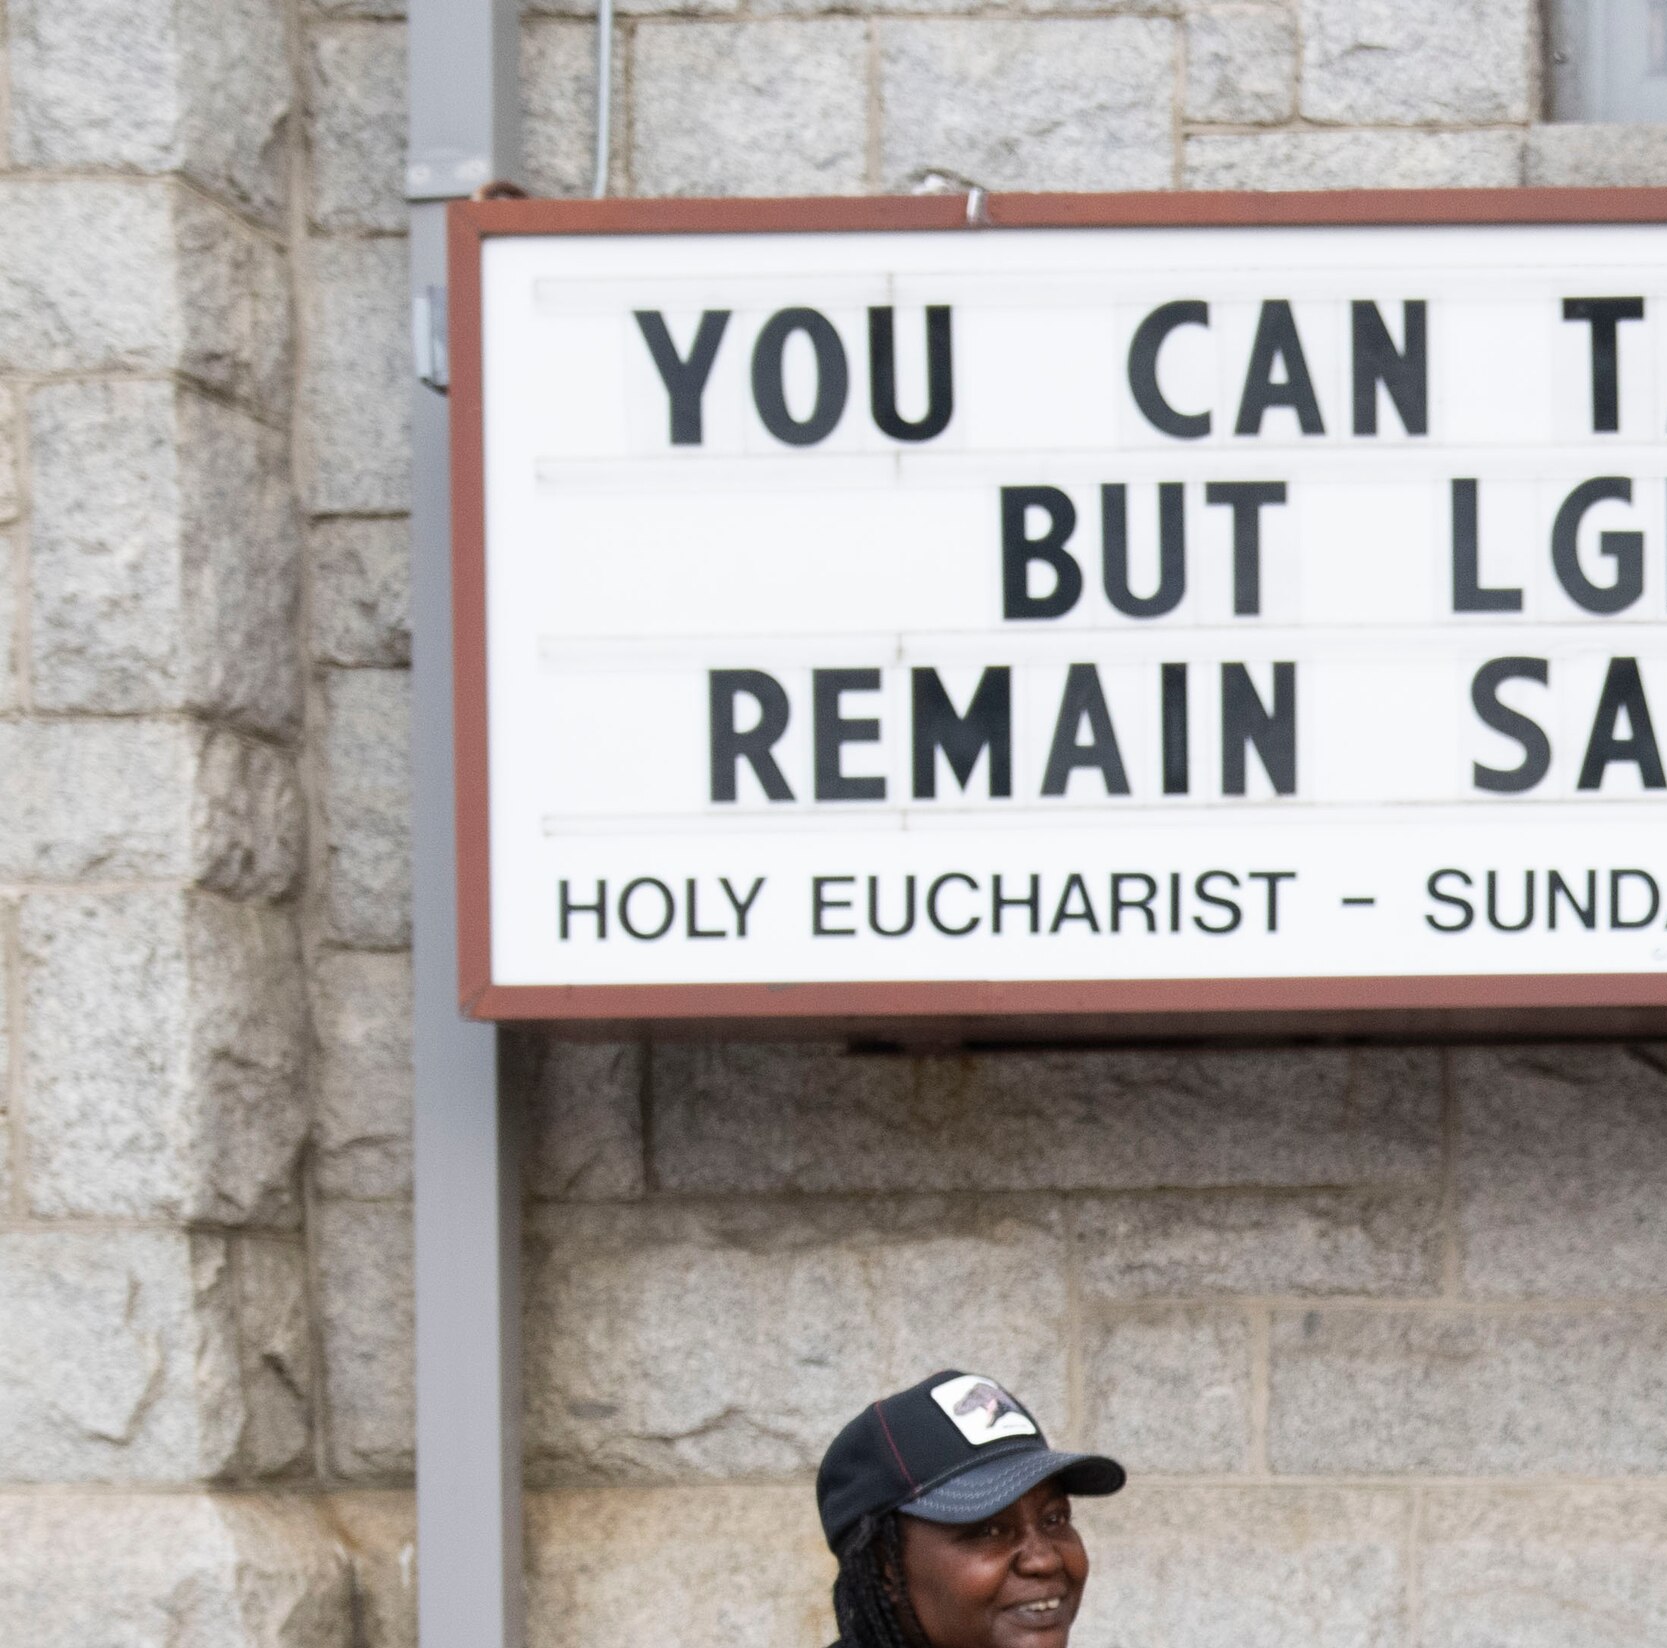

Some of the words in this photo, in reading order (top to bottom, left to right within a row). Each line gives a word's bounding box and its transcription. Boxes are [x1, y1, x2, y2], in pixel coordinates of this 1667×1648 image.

[634, 304, 954, 447] YOU
[1127, 299, 1428, 439] CAN
[1000, 481, 1287, 621] BUT
[709, 661, 1296, 802] REMAIN
[560, 877, 765, 941] HOLY
[813, 870, 1296, 937] EUCHARIST
